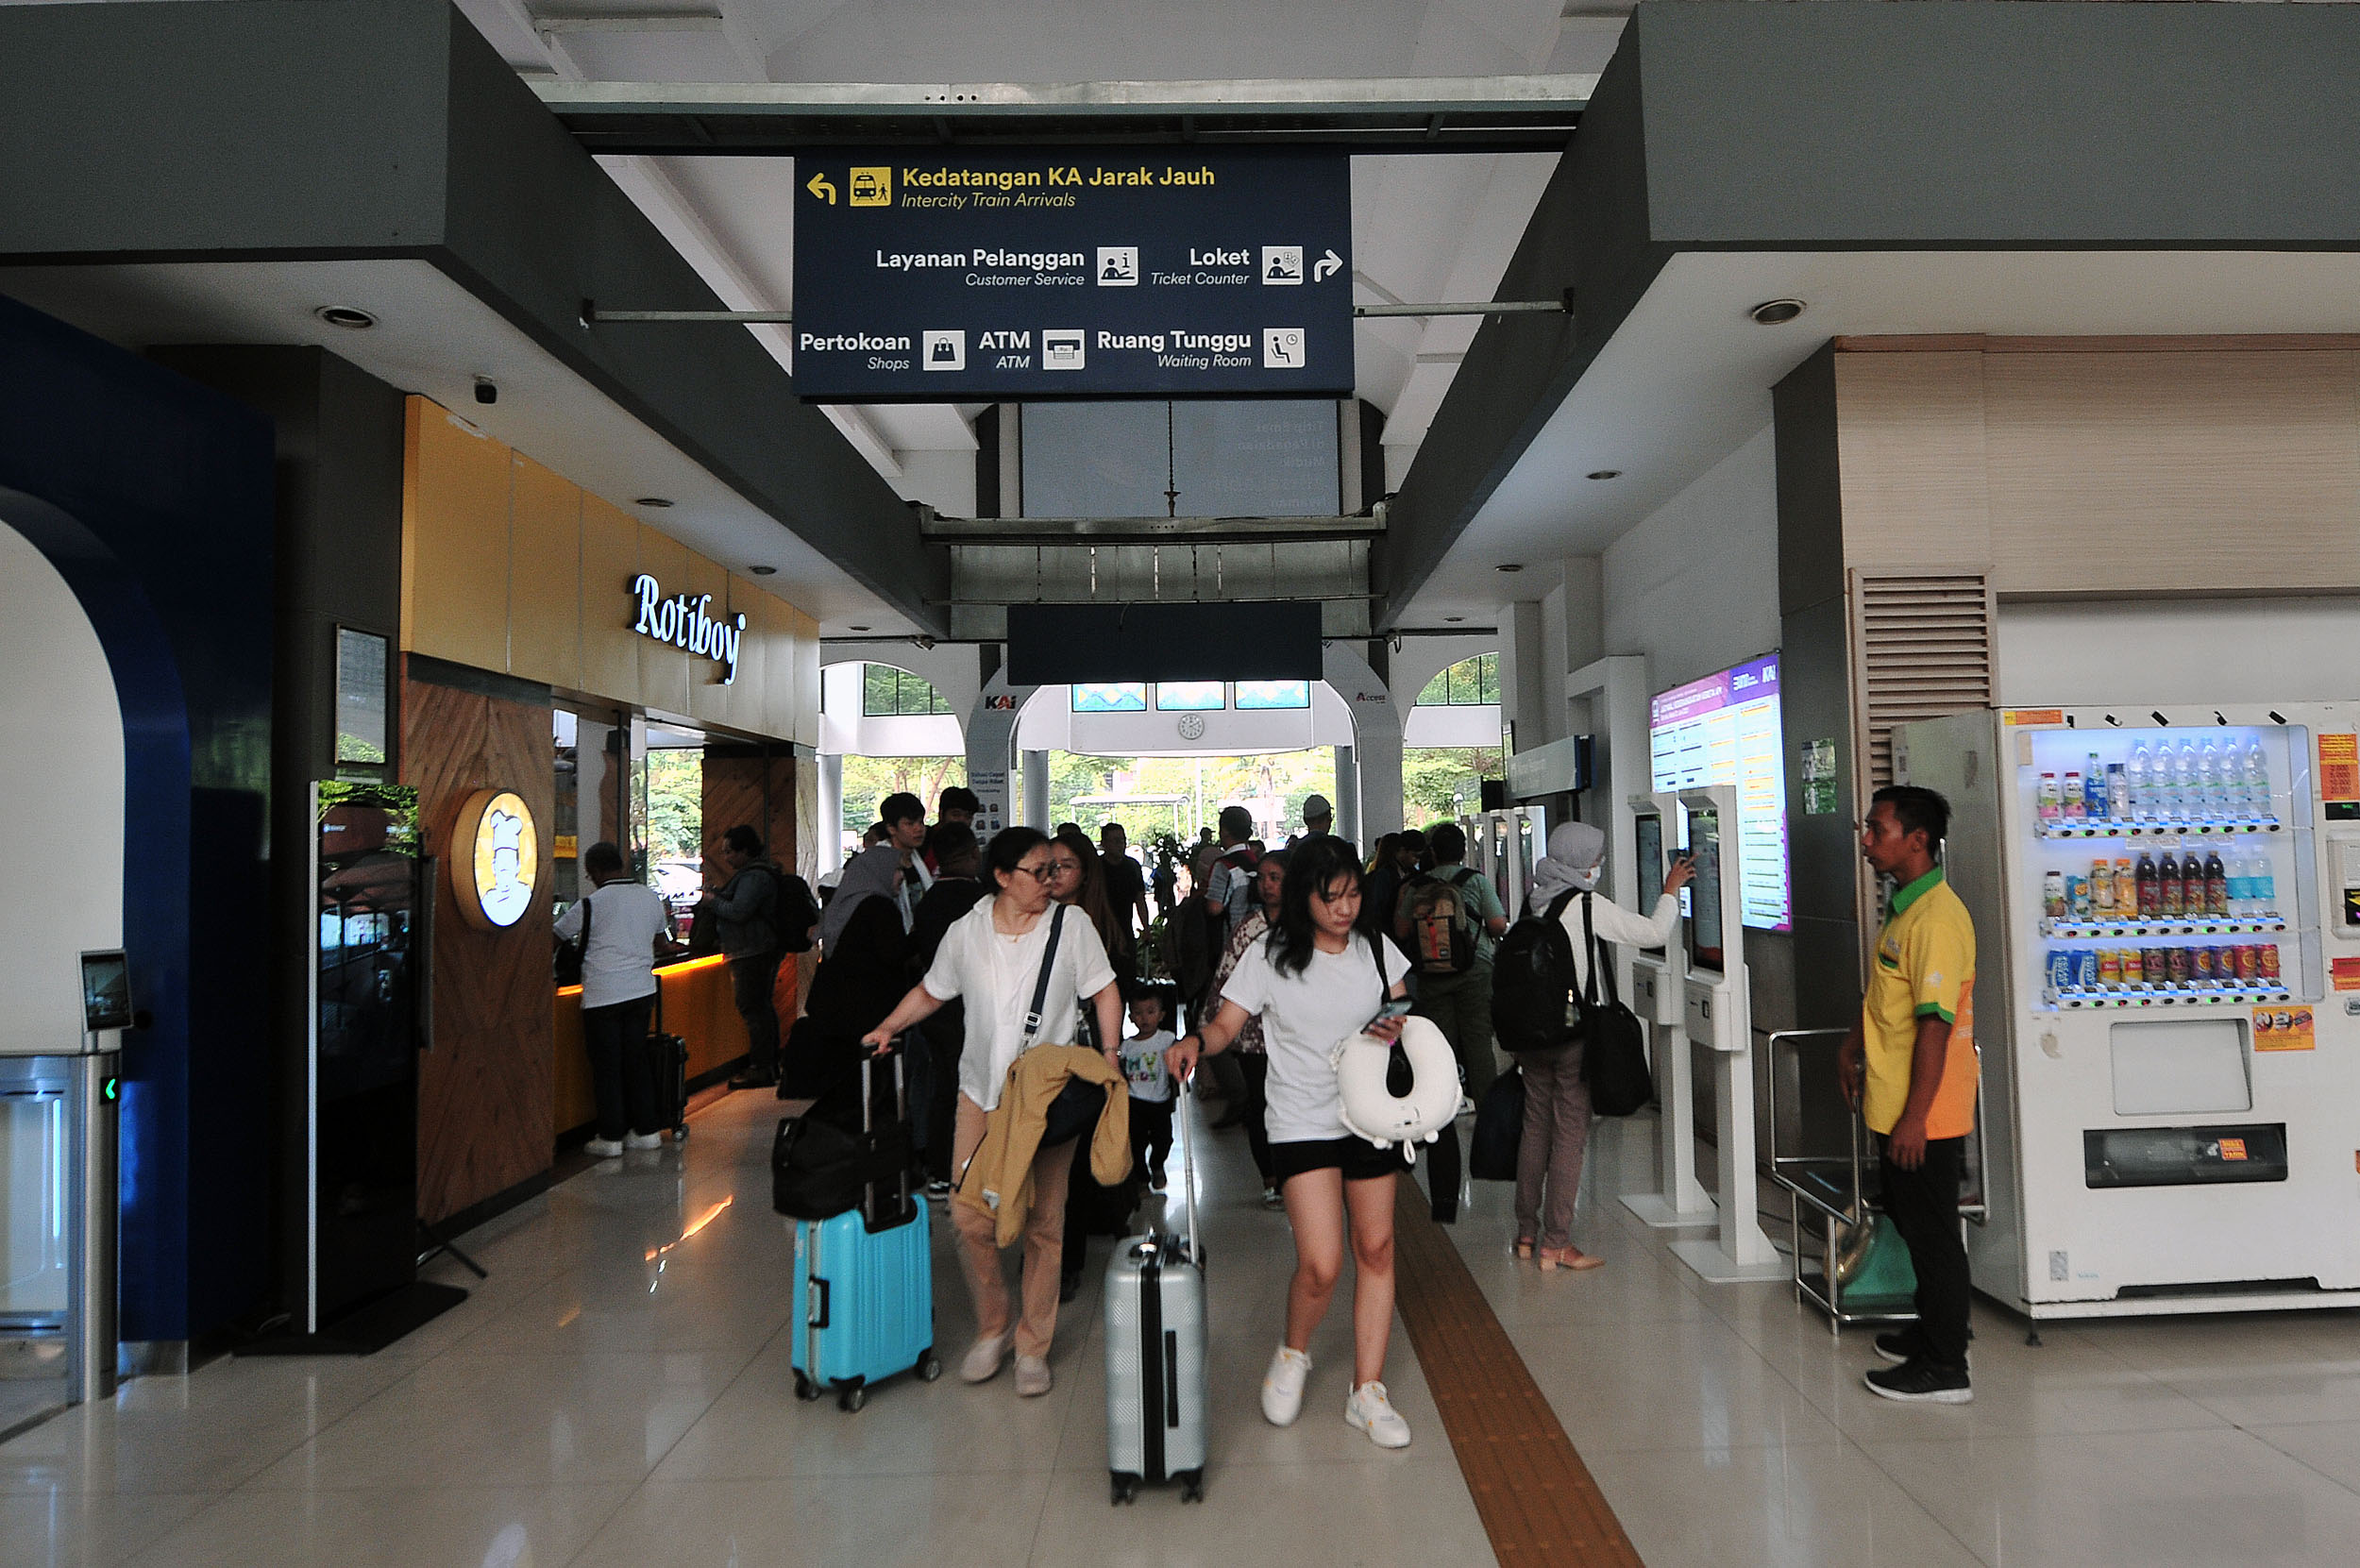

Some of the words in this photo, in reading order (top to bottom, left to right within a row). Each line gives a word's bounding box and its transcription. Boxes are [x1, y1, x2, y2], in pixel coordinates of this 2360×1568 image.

[902, 167, 1041, 191] Kedatangan
[1048, 167, 1083, 186] KA
[1089, 166, 1153, 186] Jarak
[1159, 165, 1215, 186] Jauh
[901, 192, 968, 211] Intercity
[971, 192, 1011, 207] Train
[1014, 192, 1076, 207] Arrivals
[876, 249, 967, 271] Layanan
[972, 248, 1085, 271] Pelanggan
[1189, 247, 1250, 266] Loket
[965, 273, 1033, 286] Customer
[1035, 272, 1085, 286] Service
[1151, 272, 1191, 286] Ticket
[1194, 271, 1250, 286] Counter
[800, 332, 911, 352] Pertokoan
[978, 330, 1031, 350] ATM
[1097, 330, 1165, 353] Ruang
[1170, 329, 1252, 353] Tunggu
[868, 356, 910, 374] Shops
[996, 355, 1031, 369] ATM
[1157, 353, 1209, 371] Waiting
[1212, 353, 1252, 367] Room
[634, 574, 747, 685] Rotiboy
